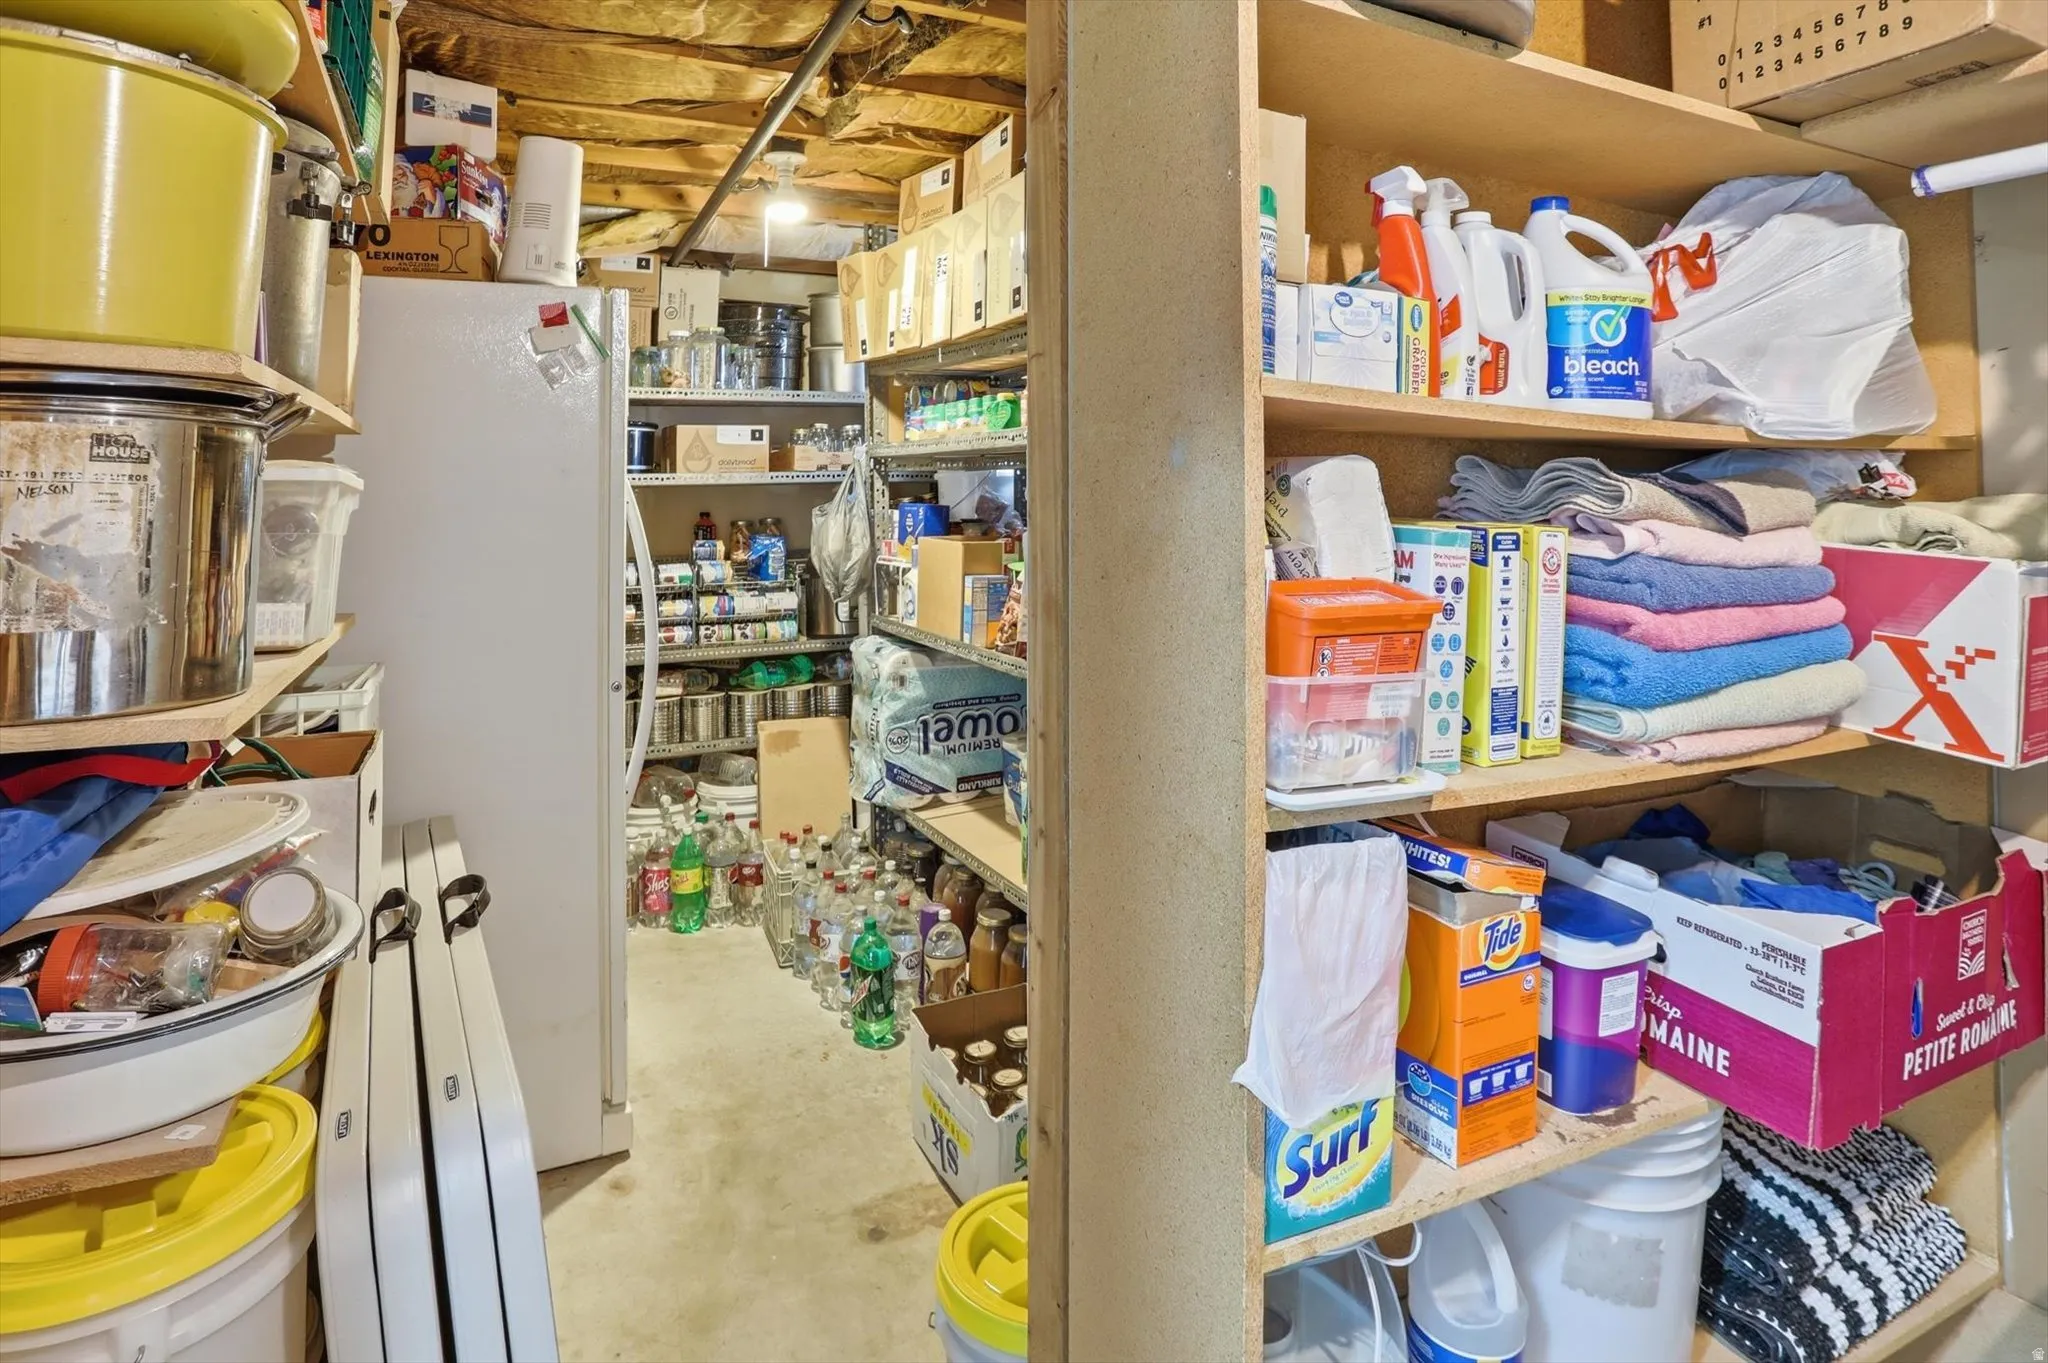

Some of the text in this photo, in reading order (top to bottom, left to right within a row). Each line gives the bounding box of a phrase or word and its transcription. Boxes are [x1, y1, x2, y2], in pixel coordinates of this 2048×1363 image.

[1698, 15, 1712, 30] #1
[1718, 0, 1888, 66] 0 1 2 3 4 5 6 7 8
[1719, 16, 1913, 90] 0 1 2 3 4 5 6 7 8 9
[366, 251, 439, 262] LEXINGTON
[1584, 294, 1600, 302] Stay
[1601, 294, 1628, 303] Brighter
[1412, 337, 1420, 394] GRABBER
[1564, 355, 1640, 376] bleach
[91, 446, 150, 459] HOUSE
[16, 482, 74, 500] NELSON
[1394, 550, 1415, 570] AM
[887, 735, 910, 746] 20%
[919, 707, 1024, 756] owel
[945, 738, 1001, 756] REMIUM
[958, 777, 1002, 792] KIRKLAND
[645, 872, 670, 895] Shas
[1484, 917, 1522, 962] Tide
[1676, 916, 1693, 928] KEEP
[1694, 923, 1743, 949] REFRIGERATED
[1761, 941, 1807, 967] PERISHABLE
[1936, 1001, 1967, 1032] Sweet
[1641, 1012, 1730, 1077] MAINE
[1903, 999, 2017, 1081] PETITE ROMAINE
[1283, 1098, 1380, 1200] Surf
